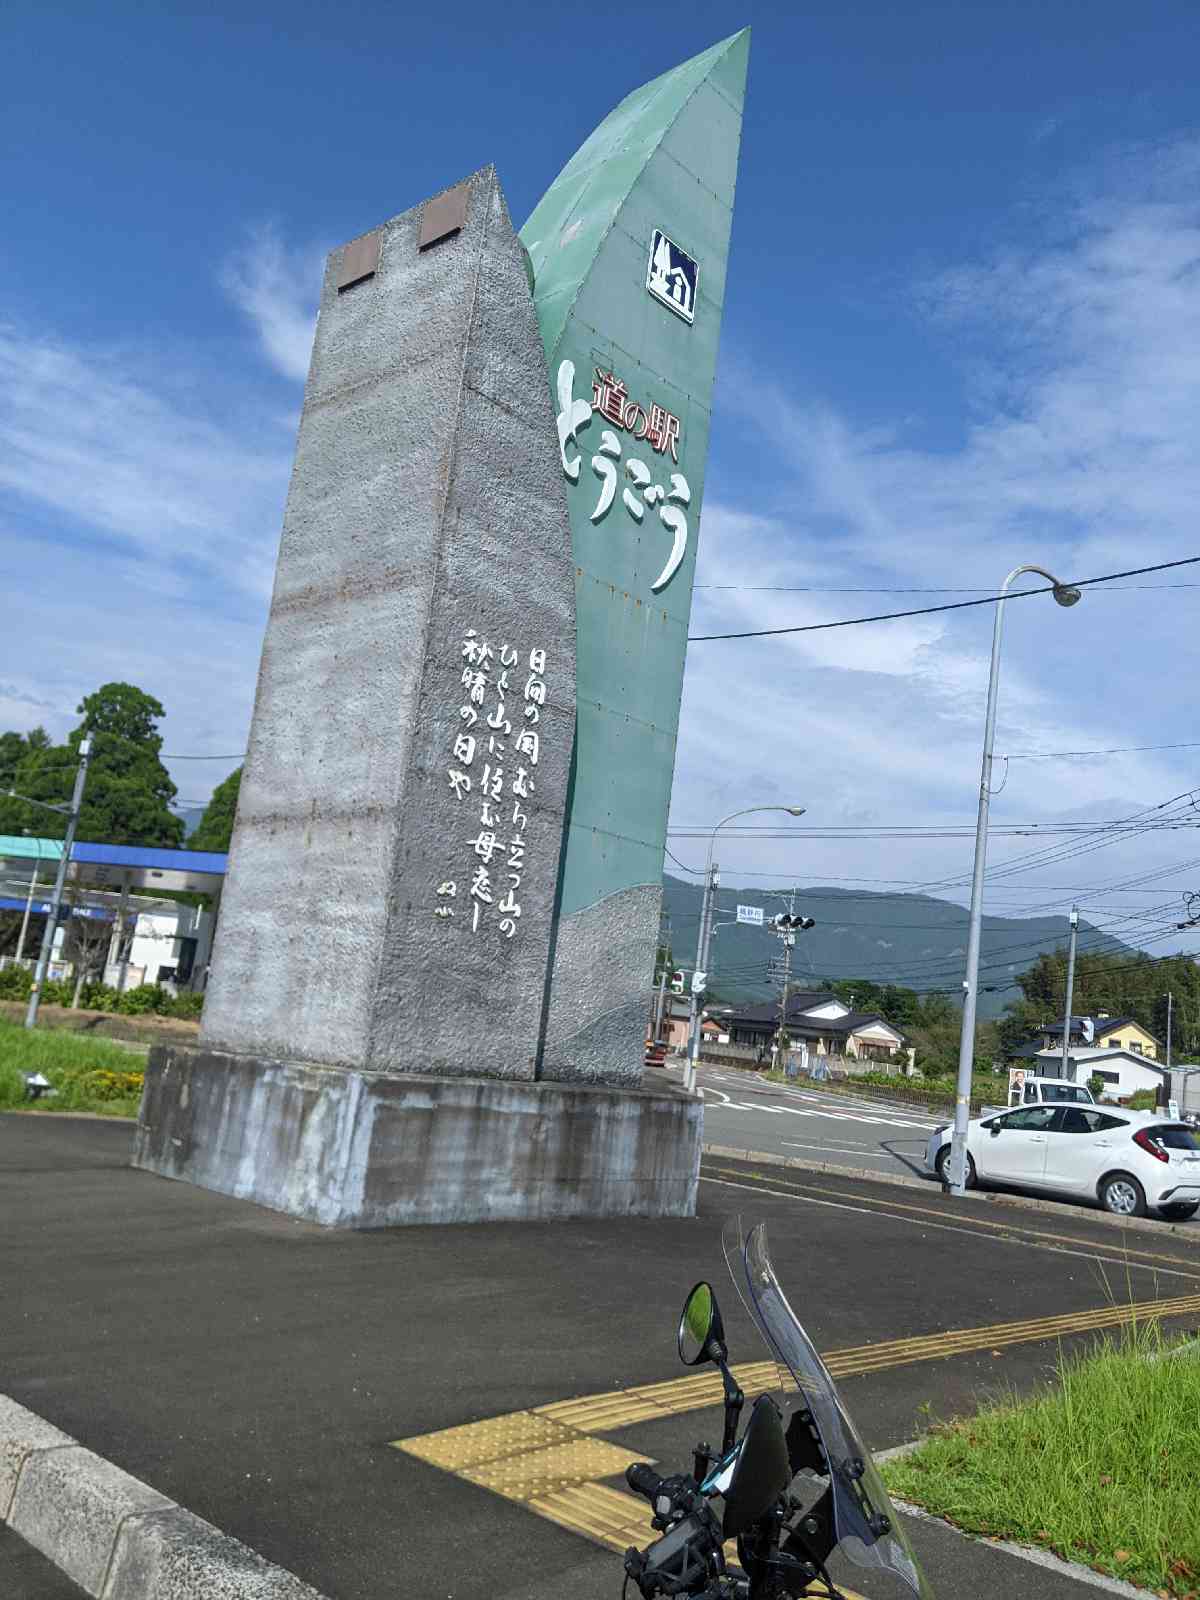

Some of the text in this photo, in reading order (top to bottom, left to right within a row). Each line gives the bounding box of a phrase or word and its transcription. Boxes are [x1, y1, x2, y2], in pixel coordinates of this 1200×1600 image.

[557, 360, 691, 590] とうごう
[592, 368, 680, 463] 道の駅
